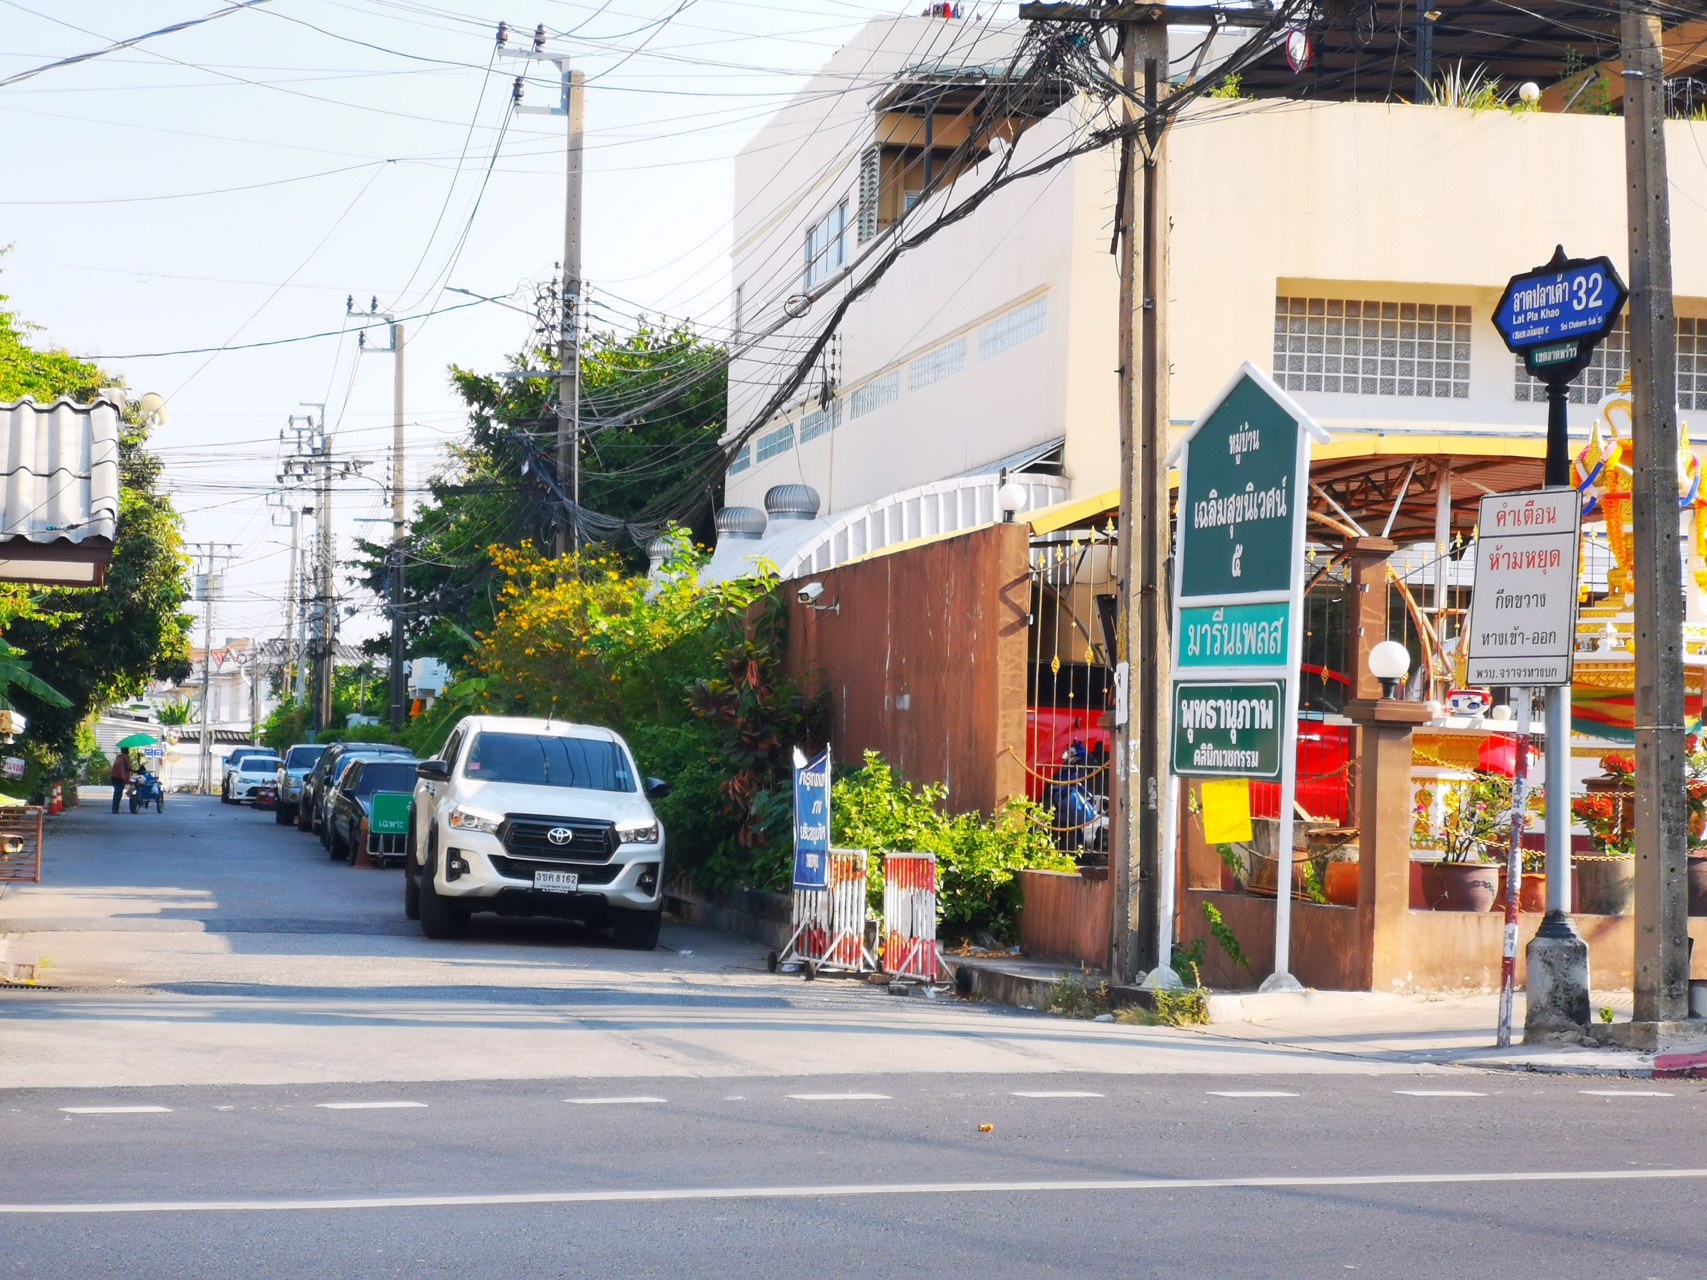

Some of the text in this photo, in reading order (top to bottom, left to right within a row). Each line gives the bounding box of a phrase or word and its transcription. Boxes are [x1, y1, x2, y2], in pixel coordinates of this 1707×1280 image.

[1513, 273, 1603, 312] ลาดปลาเค้า 32
[1512, 308, 1560, 325] Lat Pla Khao
[1535, 344, 1577, 363] เขตลาดพร้าว
[1229, 421, 1260, 465] หมู่บ้าน
[1194, 476, 1287, 539] เฉลิมสุขนิเวศน์
[1496, 499, 1557, 528] คำเตือน
[1488, 544, 1561, 575] ห้ามหยุด
[1495, 588, 1546, 610] กีดขวาง
[1188, 607, 1285, 657] มารีนเพลส
[1481, 626, 1557, 646] ทางเข้า-ออก
[1181, 698, 1274, 744] พุทธานุภาพ
[1193, 743, 1259, 768] คลินิกเวชกรรม
[378, 820, 404, 829] เฉพาะ
[555, 873, 577, 884] 8162
